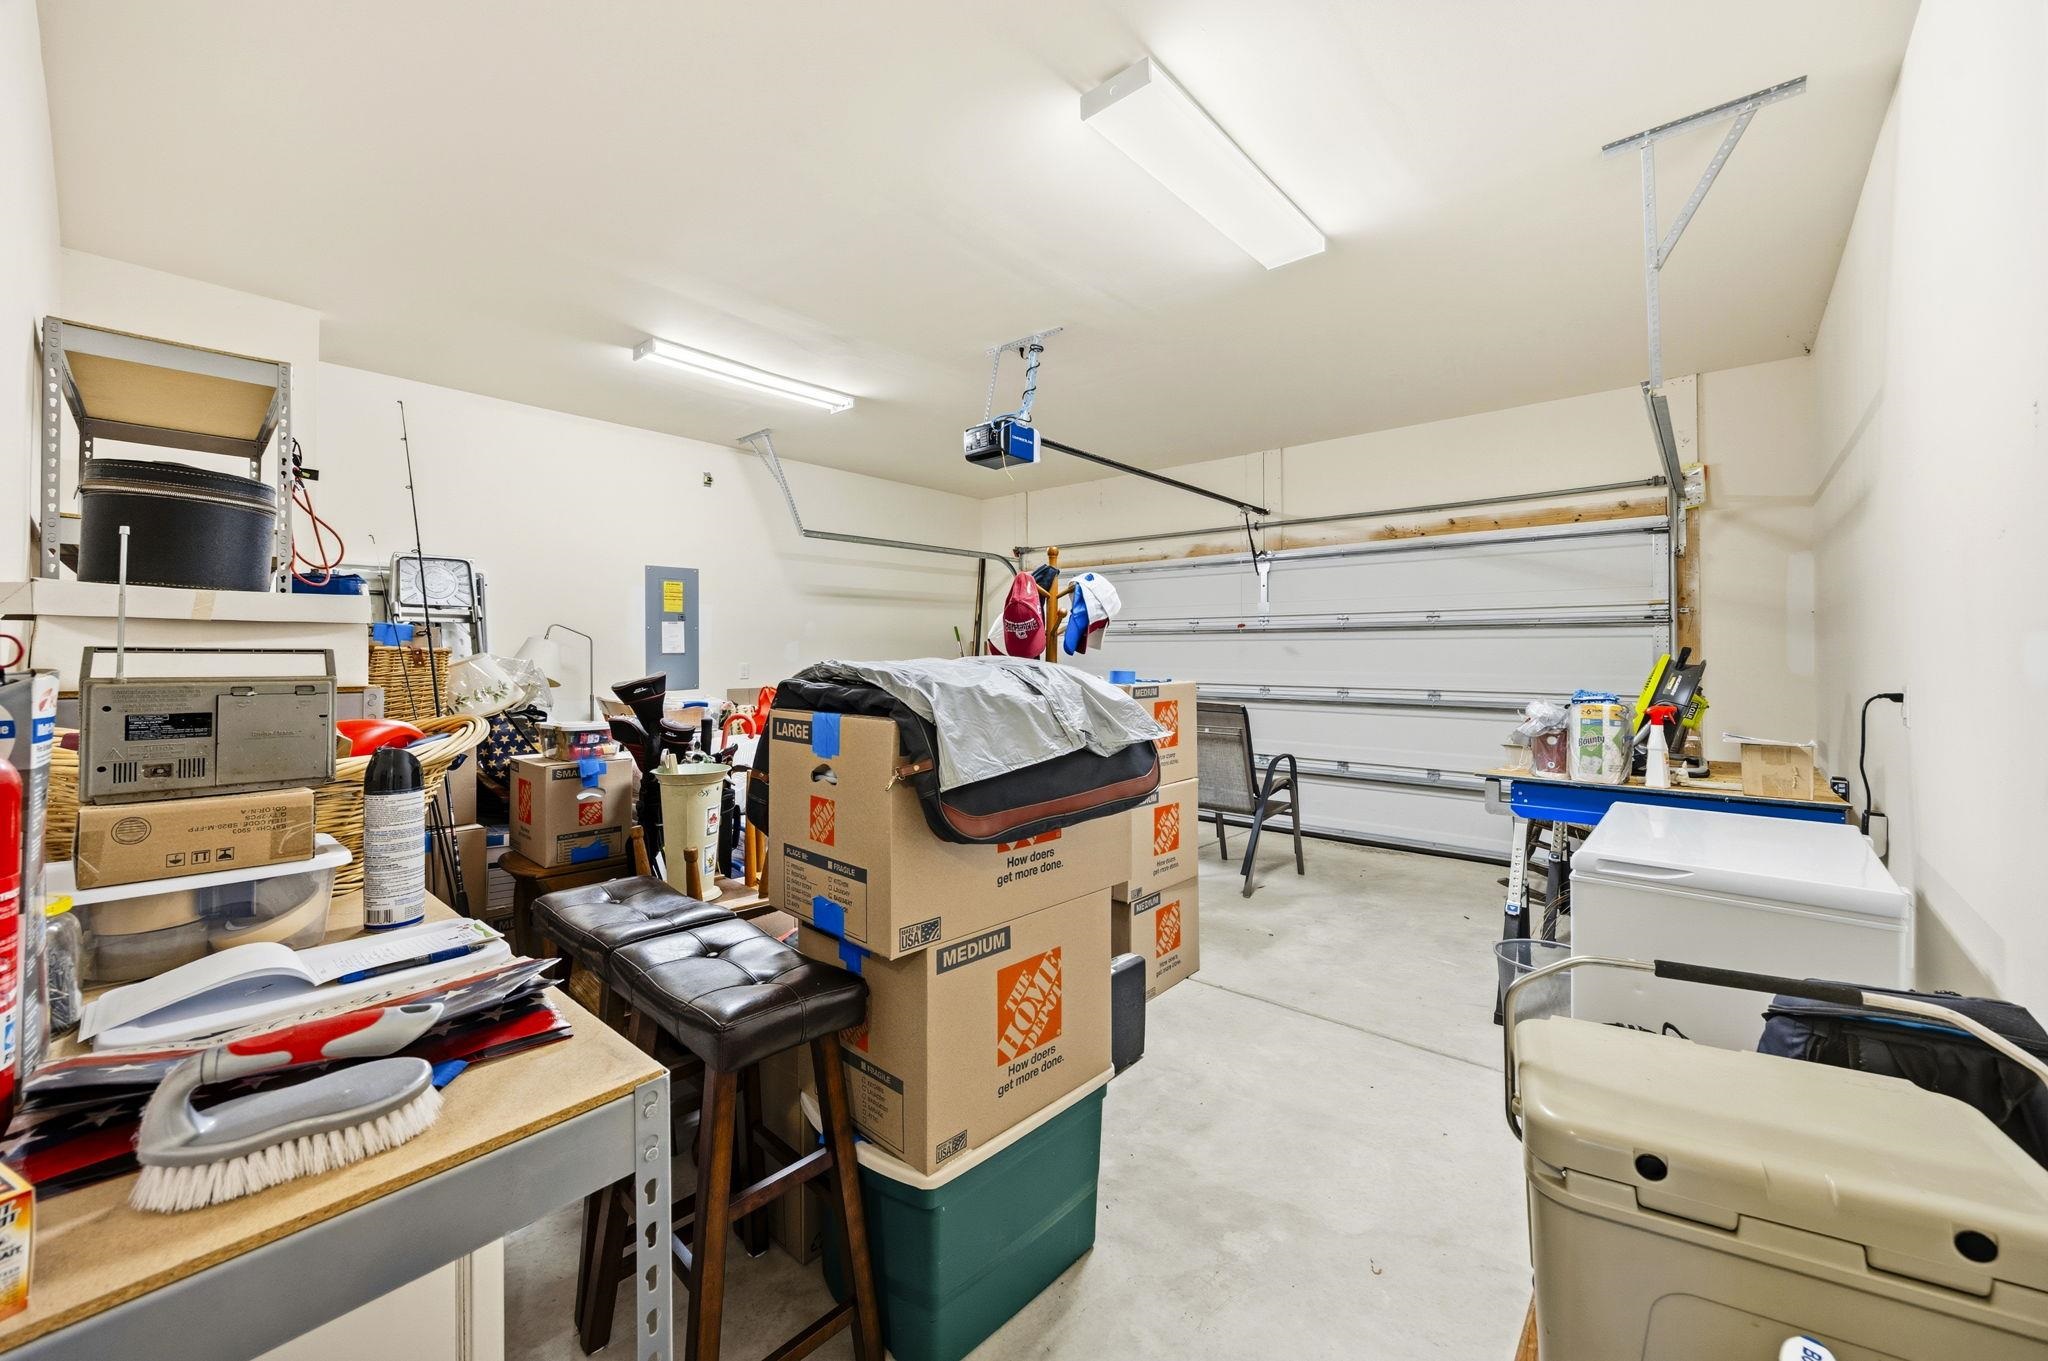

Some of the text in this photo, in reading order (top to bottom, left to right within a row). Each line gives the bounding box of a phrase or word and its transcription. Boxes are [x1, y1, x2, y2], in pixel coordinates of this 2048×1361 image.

[1135, 687, 1158, 697] MEDIUM
[776, 722, 809, 740] LARGE
[1578, 735, 1605, 747] Bounty
[556, 770, 578, 779] SMA
[1007, 848, 1055, 868] How doers
[833, 862, 856, 877] FRAGILE
[997, 860, 1064, 887] get more done.
[1136, 895, 1159, 911] MEDIUM
[902, 931, 920, 949] USA
[943, 932, 1005, 968] MEDIUM
[1004, 970, 1032, 1014] THE
[997, 950, 1062, 1060] HOME
[1024, 980, 1063, 1050] DEPOT
[1008, 1045, 1056, 1077] How doers
[867, 1064, 891, 1083] FRAGILE
[997, 1054, 1064, 1098] get more done.
